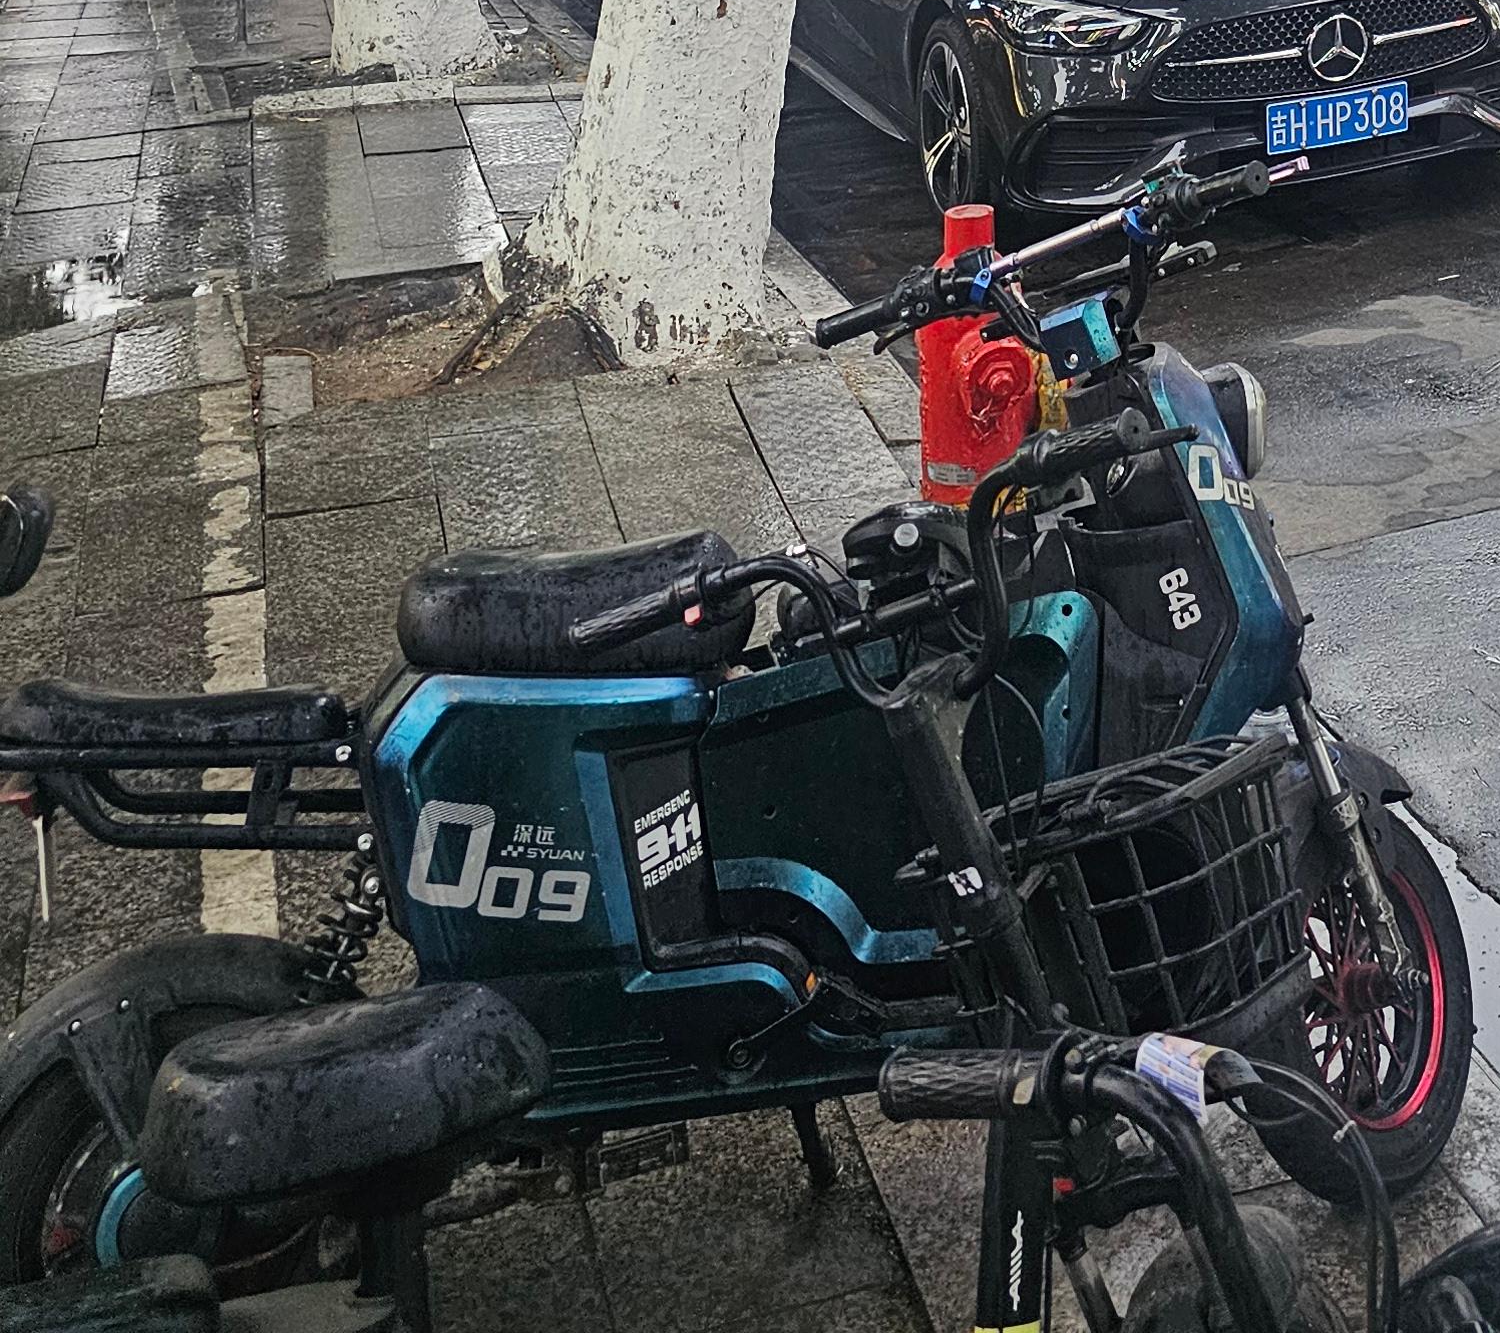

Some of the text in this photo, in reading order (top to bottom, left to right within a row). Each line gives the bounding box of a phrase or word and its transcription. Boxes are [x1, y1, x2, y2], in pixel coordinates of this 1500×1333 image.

[1158, 566, 1202, 631] 643
[512, 824, 556, 846] 深远
[526, 847, 586, 862] SYUAN
[642, 840, 705, 891] RESPONSE
